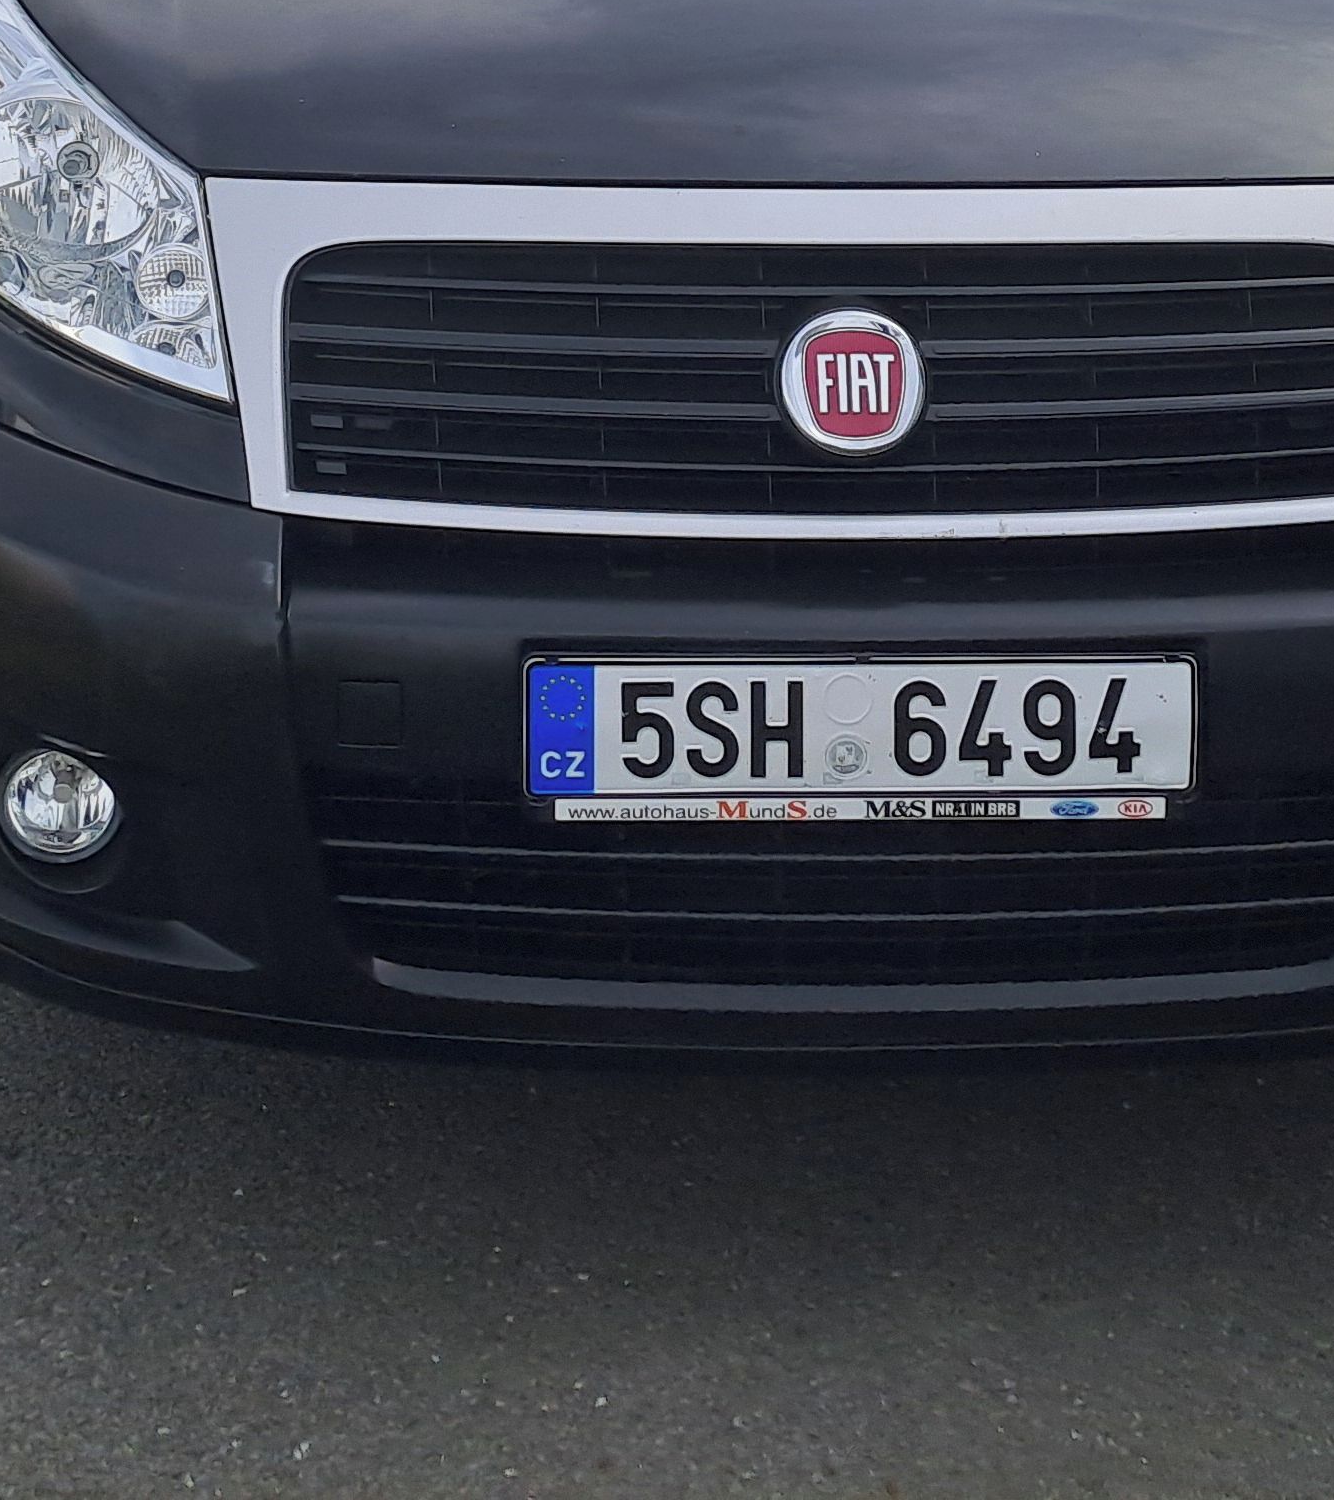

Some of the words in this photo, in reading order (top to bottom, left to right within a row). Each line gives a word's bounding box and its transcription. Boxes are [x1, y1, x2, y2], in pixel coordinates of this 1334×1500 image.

[816, 353, 895, 414] FIAT
[621, 680, 804, 779] 5SH
[894, 678, 1141, 777] 6494
[540, 750, 586, 779] CZ
[568, 800, 838, 819] www.autohaus-MundS.de
[864, 800, 927, 818] M&S
[970, 802, 985, 816] IN
[988, 802, 1017, 816] BRB
[1123, 803, 1148, 814] KIA
